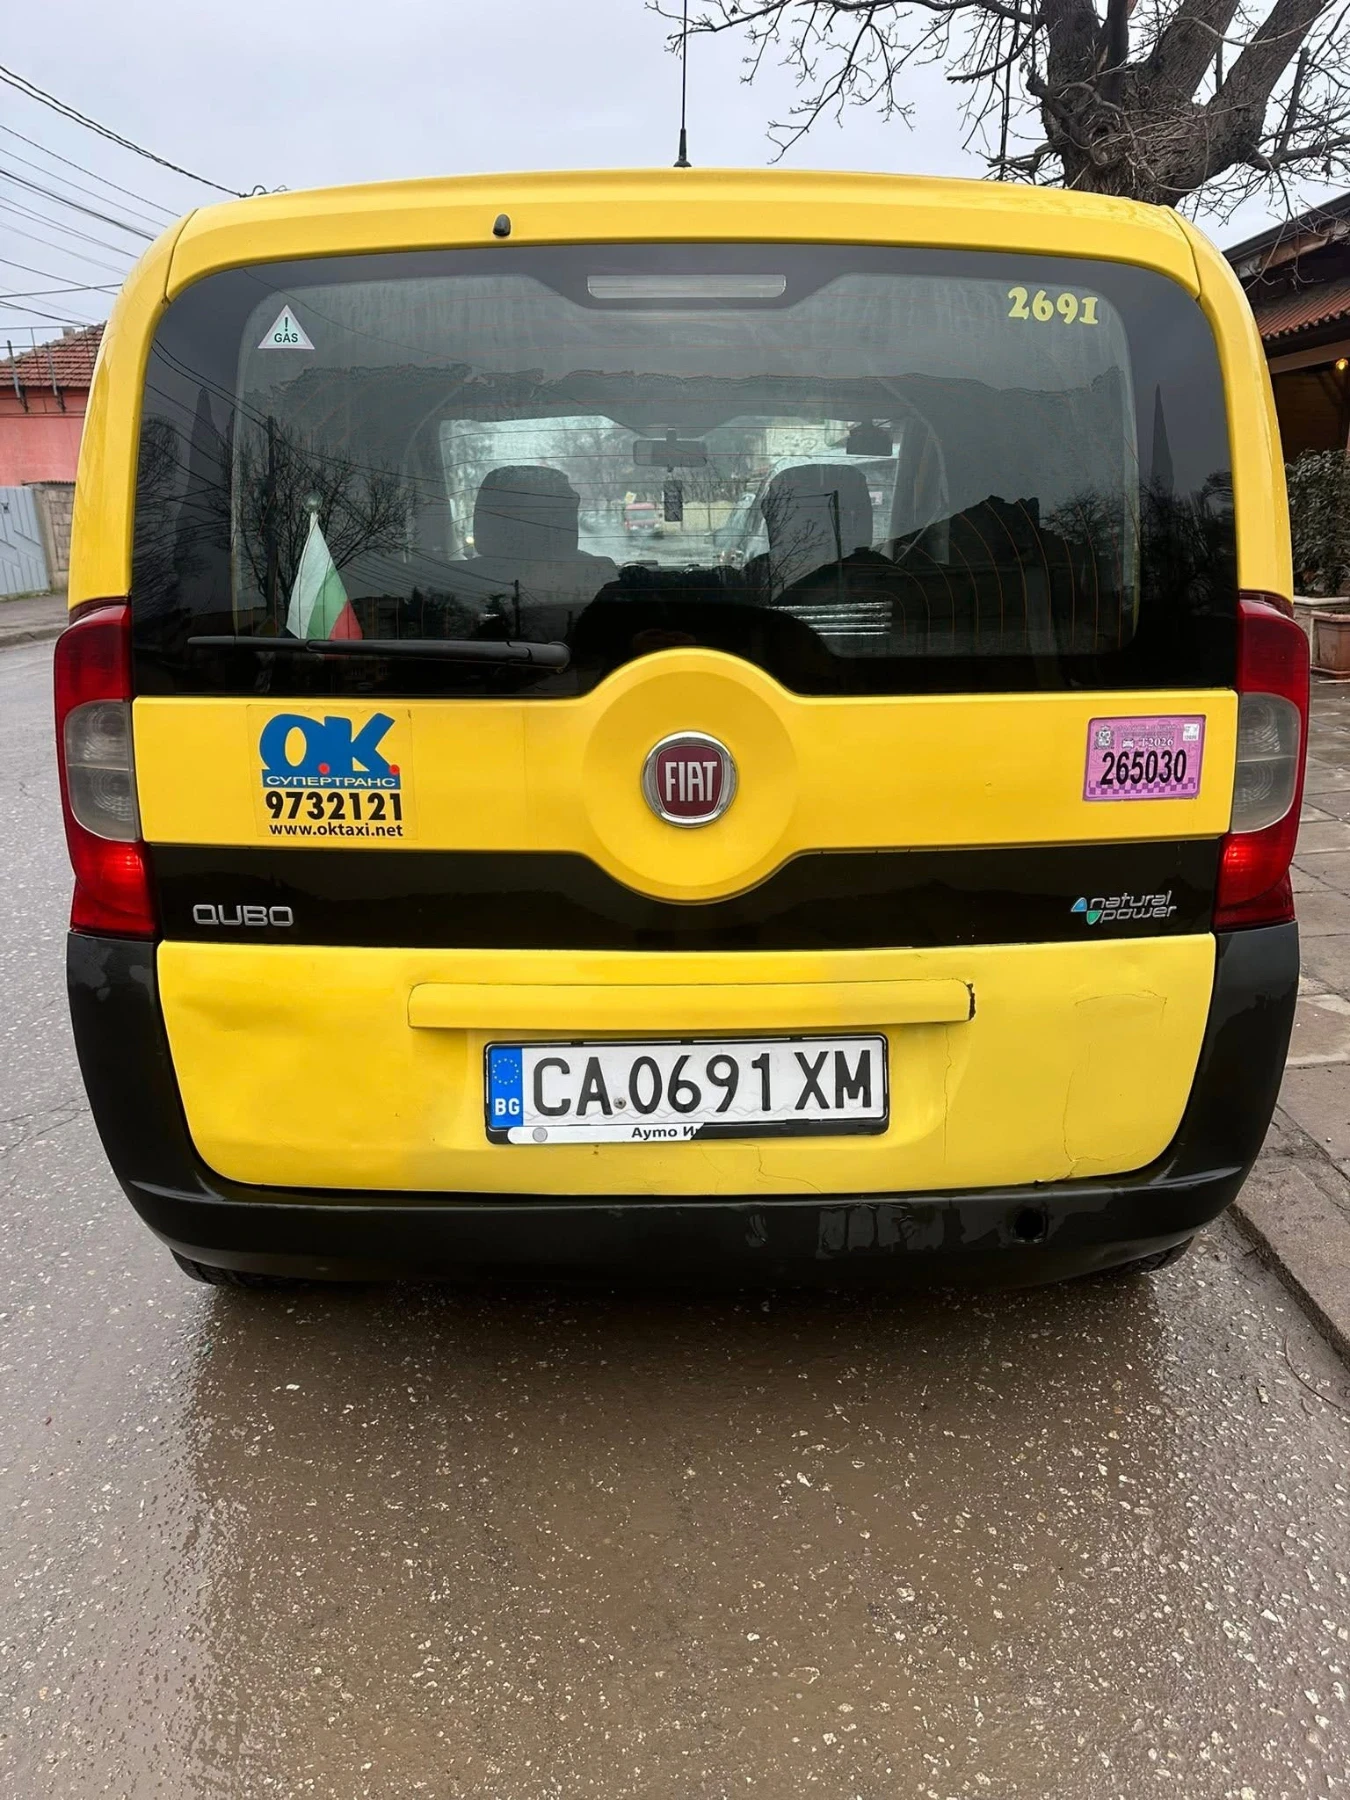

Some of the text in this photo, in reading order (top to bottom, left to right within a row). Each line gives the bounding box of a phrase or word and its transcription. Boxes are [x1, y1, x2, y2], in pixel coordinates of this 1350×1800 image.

[1008, 286, 1099, 325] 2691
[274, 333, 299, 343] GAS
[1100, 749, 1187, 785] 265030
[266, 775, 396, 787] СУПЕРТРАНС
[665, 761, 718, 802] FIAT
[265, 790, 403, 821] 9732121
[269, 821, 404, 837] www.oktaxi.net
[1090, 890, 1172, 909] natural
[192, 904, 294, 927] QUBO
[1100, 905, 1178, 924] power
[628, 1053, 772, 1115] 0691
[494, 1097, 520, 1116] BG
